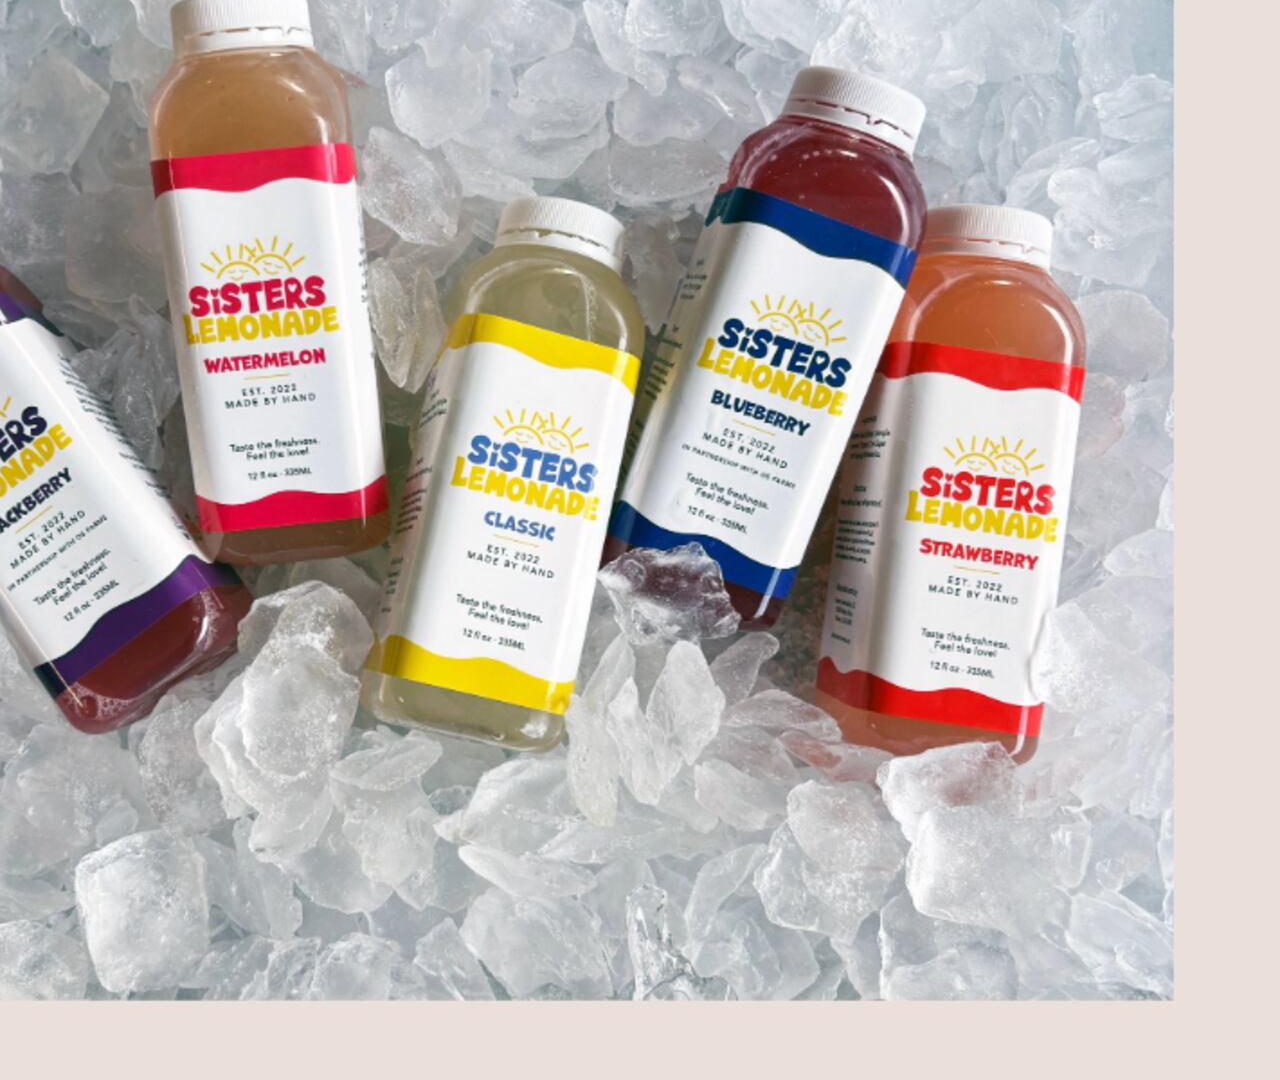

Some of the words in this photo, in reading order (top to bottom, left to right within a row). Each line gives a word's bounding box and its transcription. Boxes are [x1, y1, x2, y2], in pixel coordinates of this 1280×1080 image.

[182, 306, 340, 345] LEMONADE
[204, 348, 326, 373] WATERMELON
[696, 337, 849, 416] LEMONADE
[242, 387, 265, 396] EST.
[225, 399, 258, 409] MADE
[264, 397, 277, 405] BY
[282, 393, 316, 403] HAND
[711, 390, 810, 436] BLUEBERRY
[723, 428, 744, 443] EST.
[257, 441, 272, 449] the
[702, 433, 734, 450] MADE
[738, 446, 752, 456] BY
[756, 452, 788, 469] HAND
[247, 452, 267, 461] Feel
[270, 450, 284, 459] the
[248, 472, 257, 480] 12
[450, 456, 600, 521] LEMONADE
[710, 482, 724, 493] the
[695, 488, 714, 501] Feel
[716, 494, 732, 507] the
[905, 490, 1059, 542] LEMONADE
[18, 533, 40, 549] EST.
[42, 512, 65, 533] 2022
[484, 511, 556, 541] CLASSIC
[10, 544, 40, 569] MADE
[41, 533, 54, 546] BY
[57, 510, 86, 534] HAND
[487, 544, 508, 556] EST.
[919, 538, 1040, 571] STRAWBERRY
[467, 551, 499, 566] MADE
[504, 560, 518, 570] BY
[522, 565, 554, 579] HAND
[947, 576, 971, 587] EST.
[33, 587, 57, 605] Taste
[57, 577, 71, 589] the
[53, 590, 72, 605] Feel
[72, 579, 87, 592] the
[928, 585, 961, 596] MADE
[967, 590, 981, 599] BY
[985, 593, 1018, 605] HAND
[482, 601, 496, 611] the
[64, 612, 73, 622] 12
[468, 608, 488, 619] Feel
[490, 614, 505, 625] the
[463, 628, 472, 638] 12
[922, 627, 944, 639] Taste
[947, 632, 962, 642] the
[934, 641, 954, 651] Feel
[957, 645, 971, 654] the
[930, 661, 940, 670] 12
